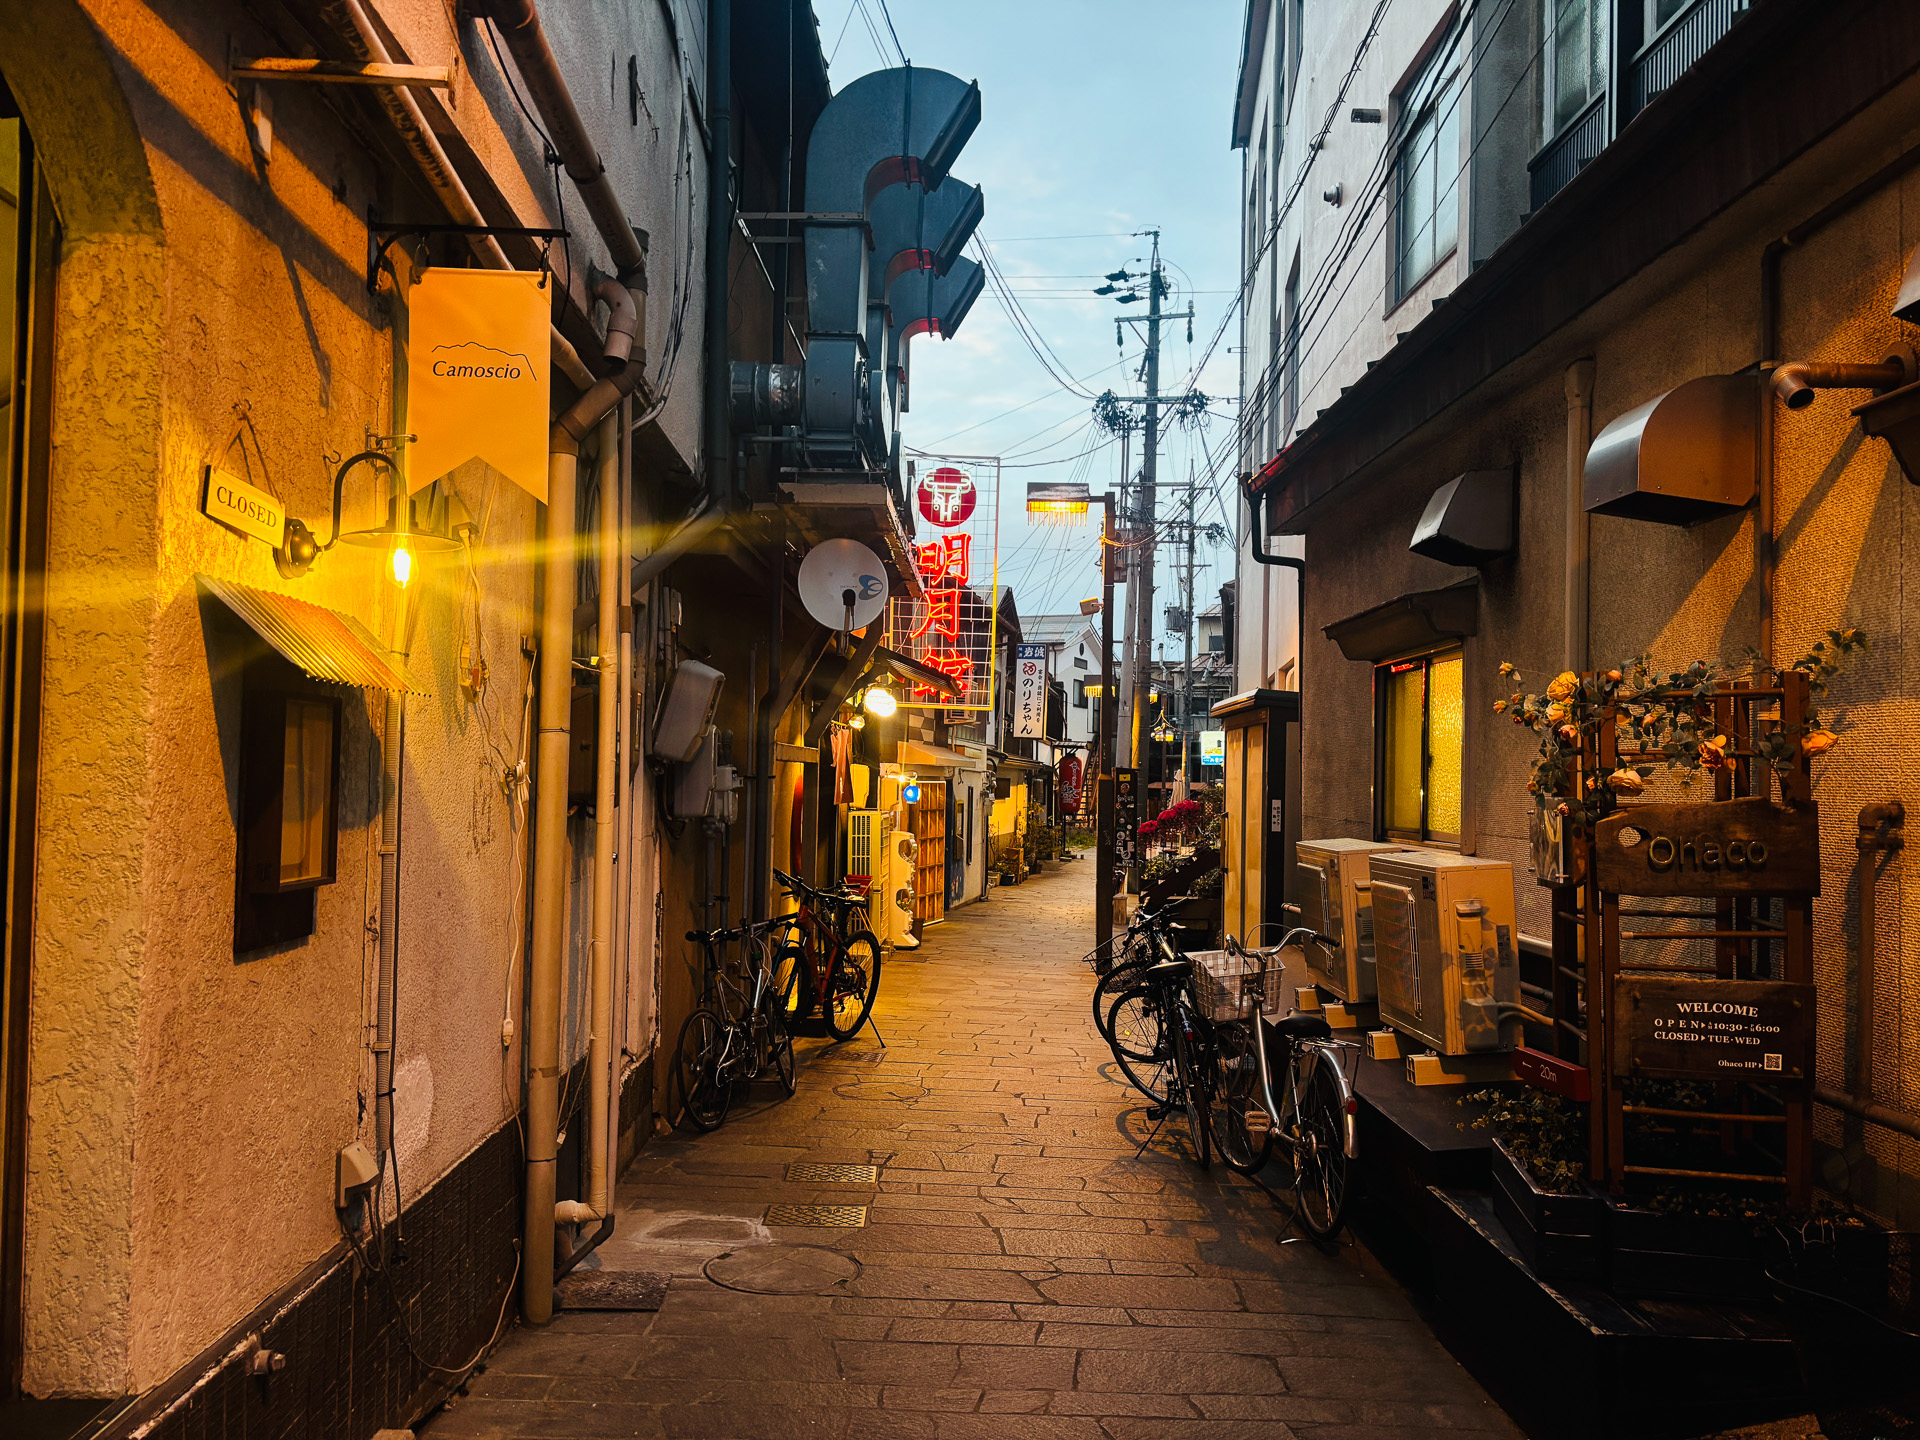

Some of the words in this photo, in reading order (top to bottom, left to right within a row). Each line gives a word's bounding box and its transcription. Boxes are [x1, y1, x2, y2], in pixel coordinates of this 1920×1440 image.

[432, 360, 521, 379] Camoscio
[216, 486, 277, 528] CLOSED
[1020, 678, 1034, 735] のりちゃん
[1649, 836, 1768, 864] Ohaco
[1676, 1002, 1759, 1018] WELCOME
[1654, 1031, 1699, 1042] CLOSED
[1540, 1064, 1557, 1083] 20m
[1718, 1059, 1743, 1068] Ohaco
[1744, 1061, 1758, 1069] HP
